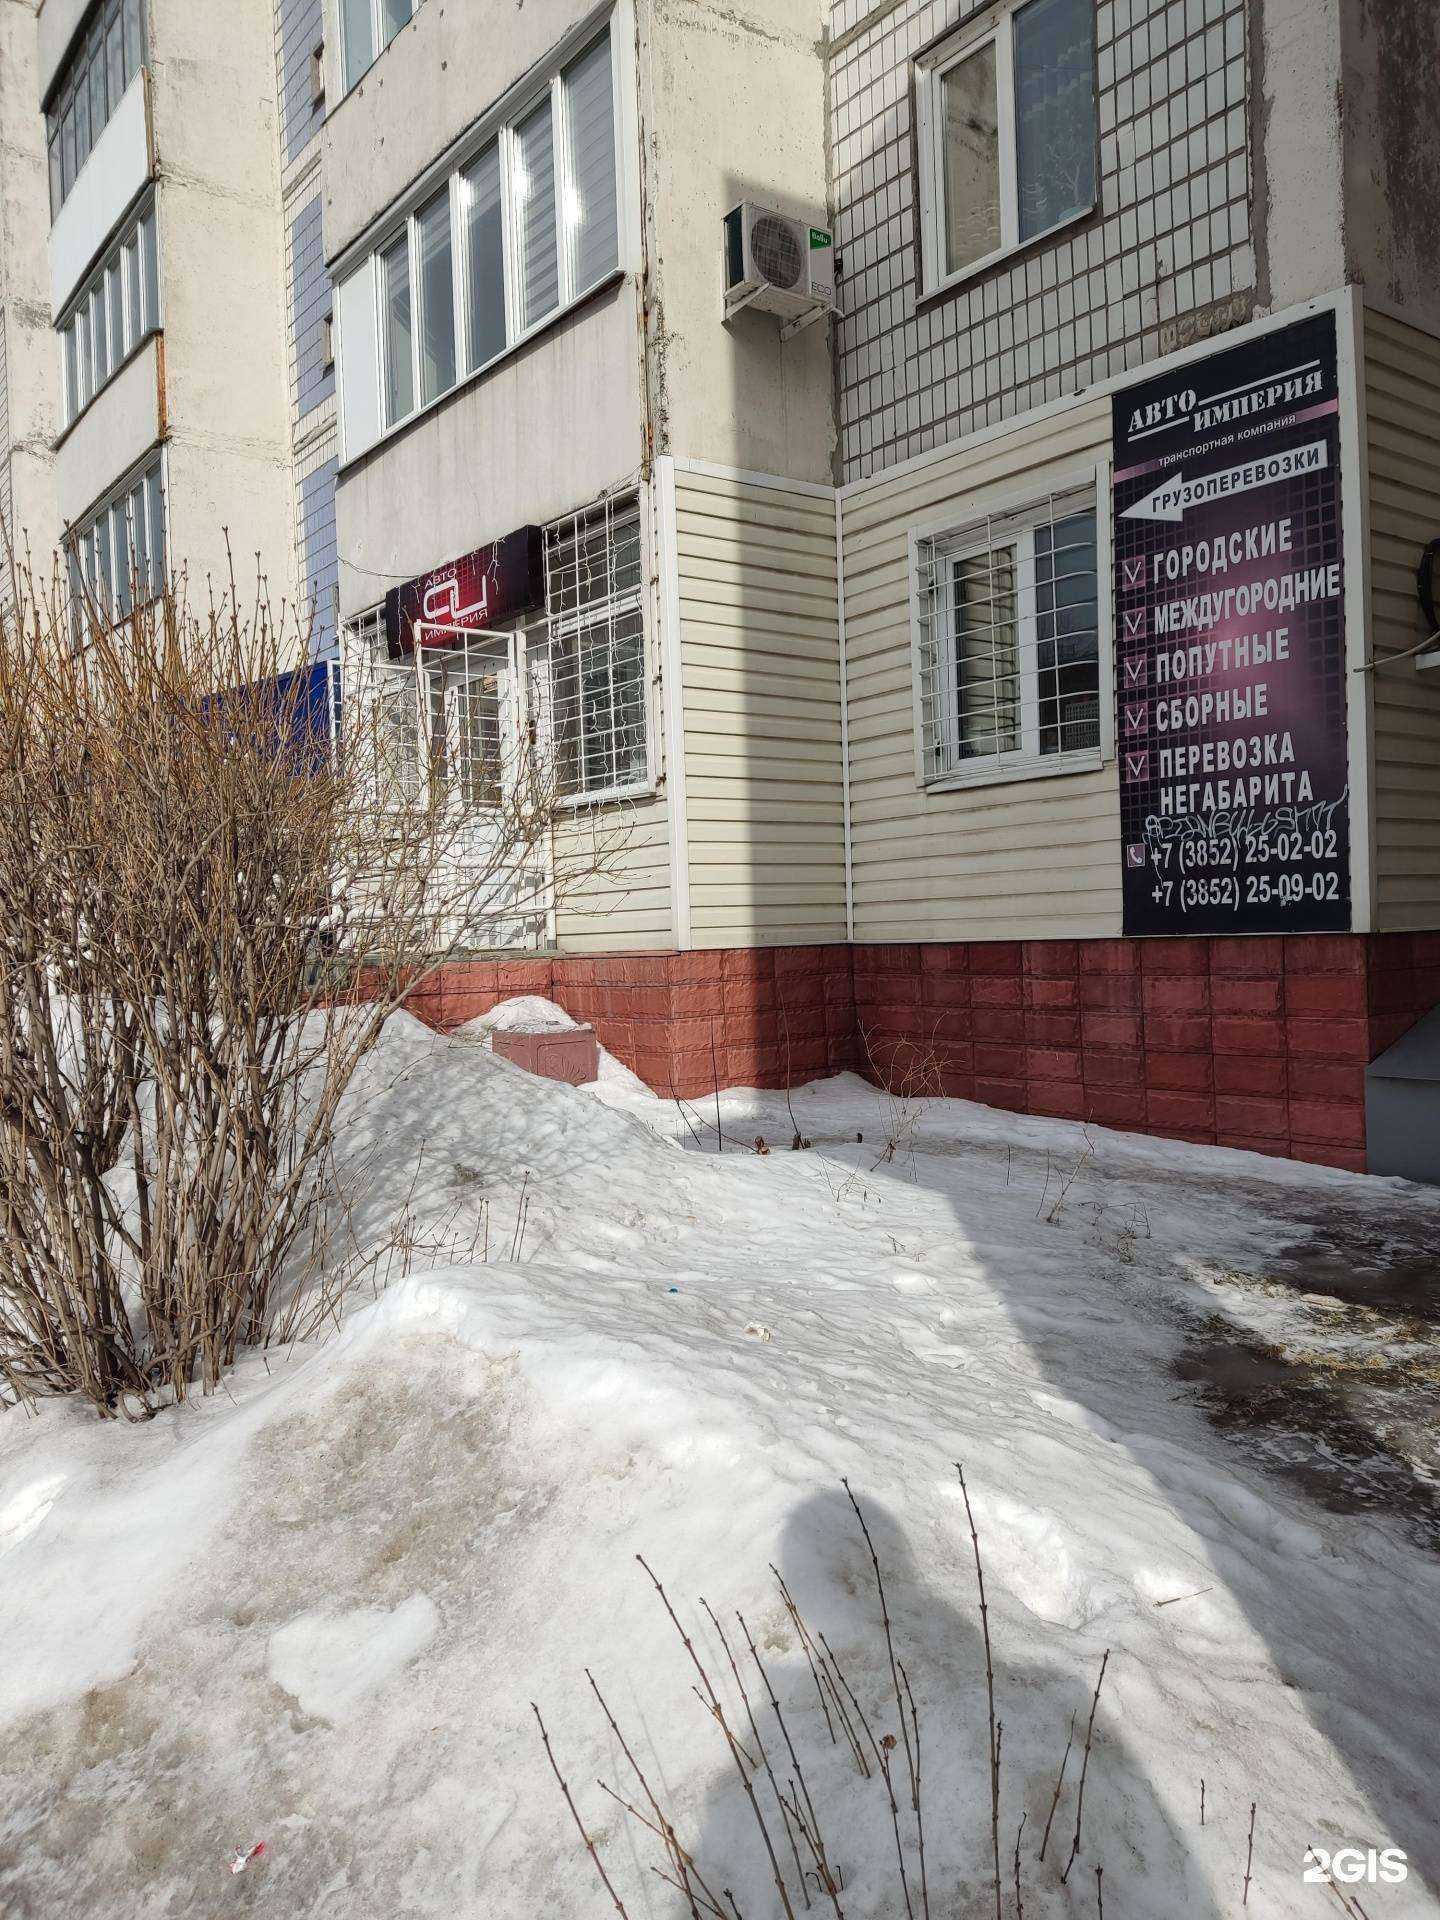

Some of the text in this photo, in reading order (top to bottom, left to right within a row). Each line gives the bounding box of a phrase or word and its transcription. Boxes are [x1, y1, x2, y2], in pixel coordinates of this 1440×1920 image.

[1127, 370, 1323, 432] АВТО ИМПЕРИЯ
[1158, 414, 1296, 468] транспортная компания
[1152, 447, 1320, 513] ГРУЗОПЕРЕВОЗКИ
[1153, 518, 1293, 584] ГОРОДСКИЕ
[424, 568, 457, 589] АВТО
[1154, 563, 1341, 635] МЕЖДУГОРОДНИЕ
[1156, 628, 1289, 683] ПОПУТНЫЕ
[1156, 683, 1268, 731] СБОРНЫЕ
[1159, 731, 1295, 779] ПЕРЕВОЗКА
[1161, 770, 1313, 815] НЕГАБАРИТА
[1151, 829, 1337, 875] +7 (3852) 25-02-02
[1152, 871, 1339, 912] +7 (3852) 25-09-02
